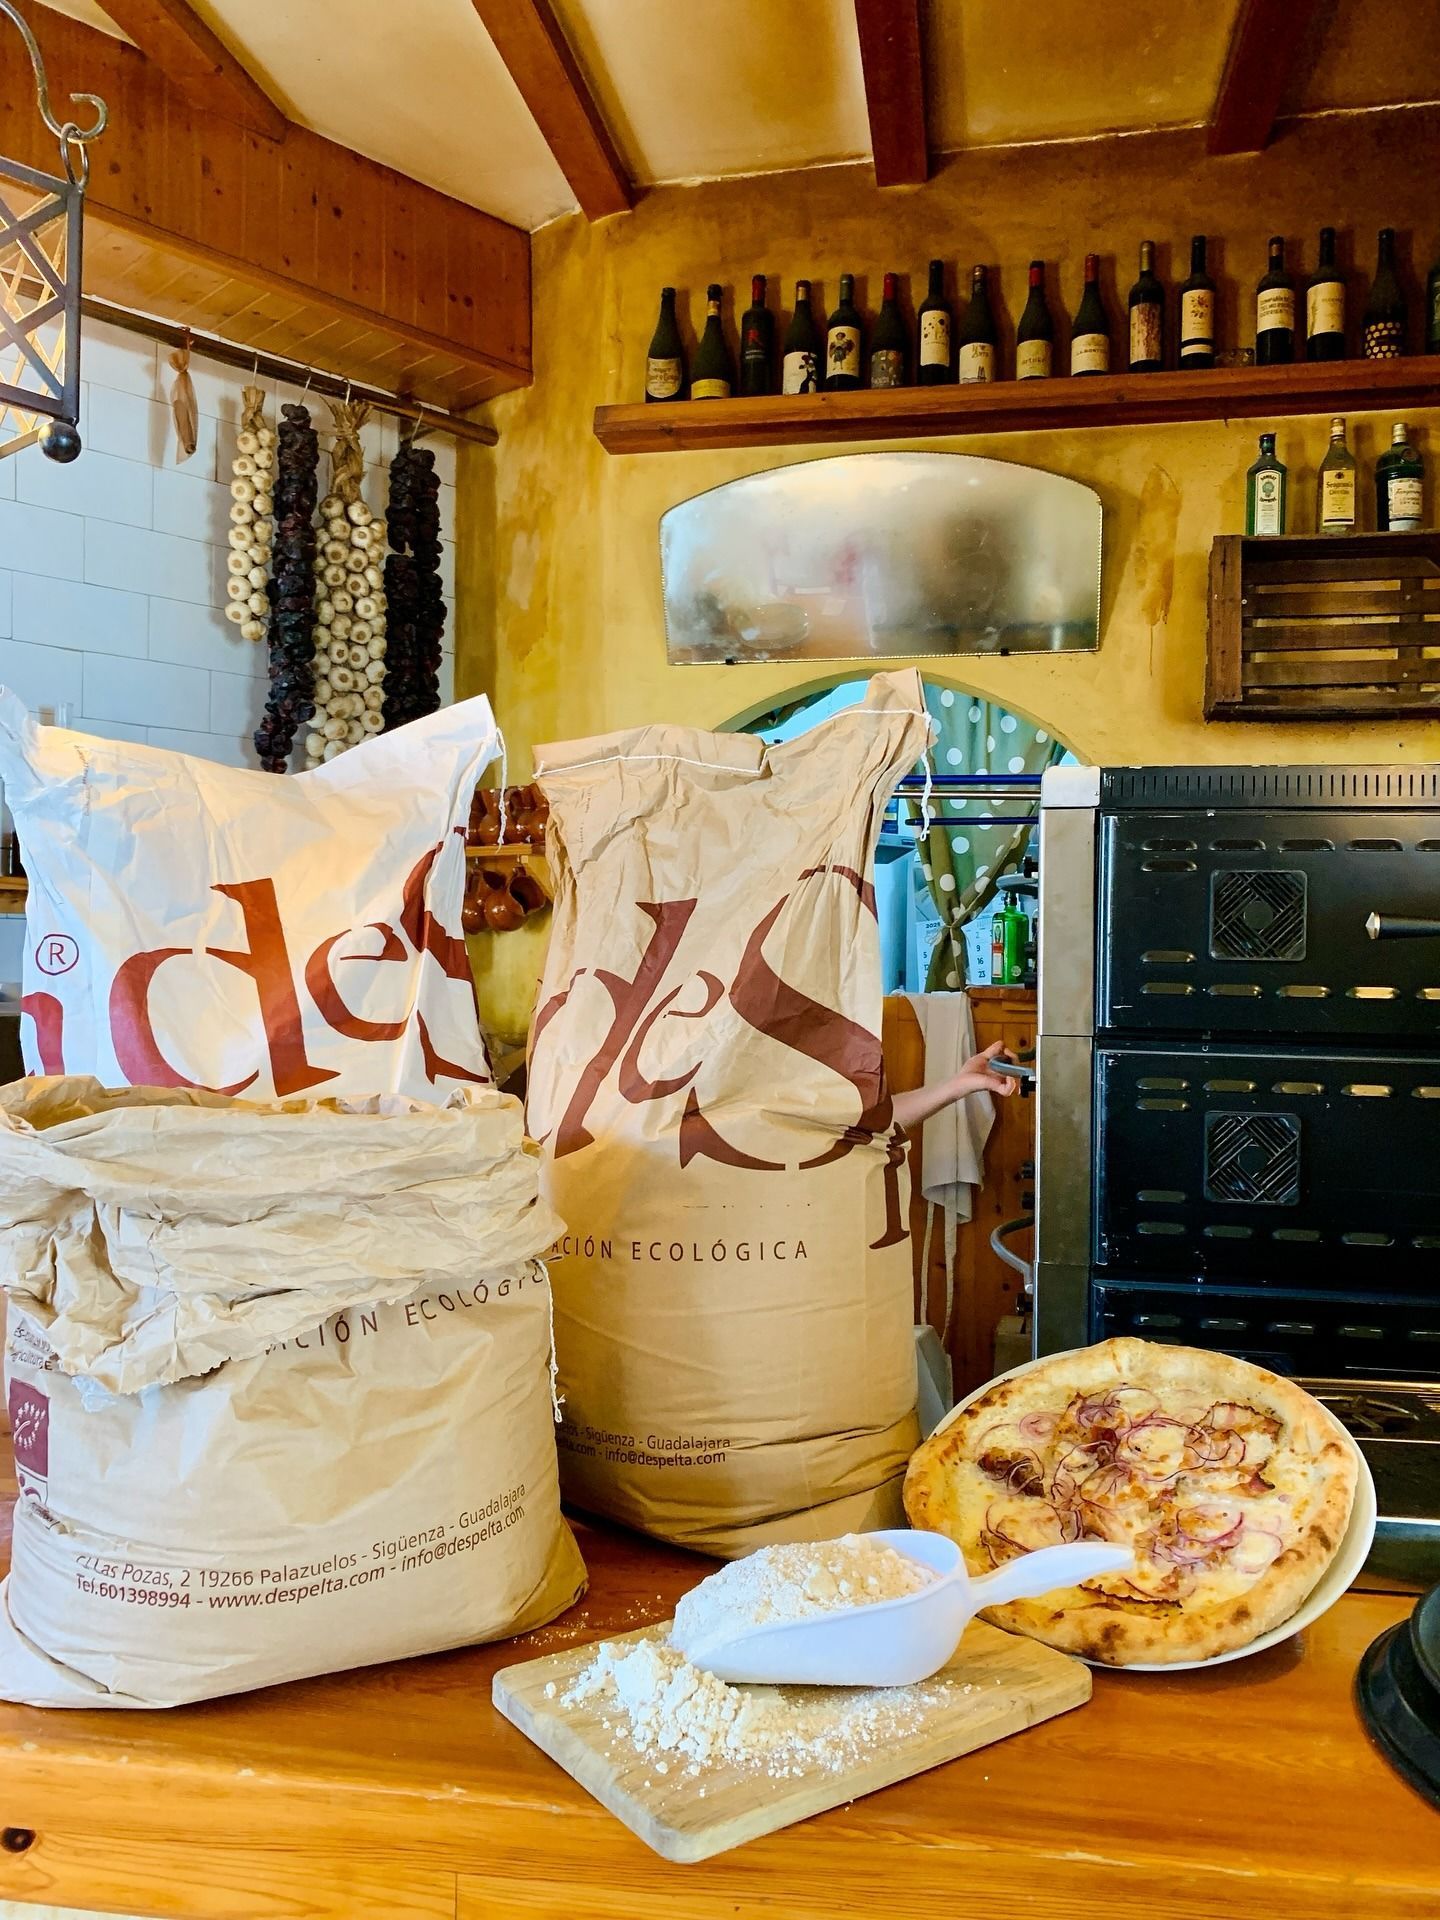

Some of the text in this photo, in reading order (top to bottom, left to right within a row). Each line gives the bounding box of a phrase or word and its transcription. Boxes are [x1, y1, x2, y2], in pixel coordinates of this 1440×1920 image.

[631, 1239, 808, 1262] ECOLÓGICA
[586, 1426, 635, 1447] Sigüenza
[647, 1434, 731, 1451] Guadalajara
[605, 1446, 726, 1470] info@despelta.com
[121, 1563, 173, 1589] Pozas,
[180, 1569, 191, 1587] 2
[199, 1570, 254, 1587] 19266
[260, 1554, 357, 1584] Palazuelos
[372, 1525, 445, 1559] Sigüenza
[459, 1483, 526, 1529] Guadalajara
[208, 1566, 385, 1609] www.despelta.com
[401, 1504, 526, 1572] info@despelta.com
